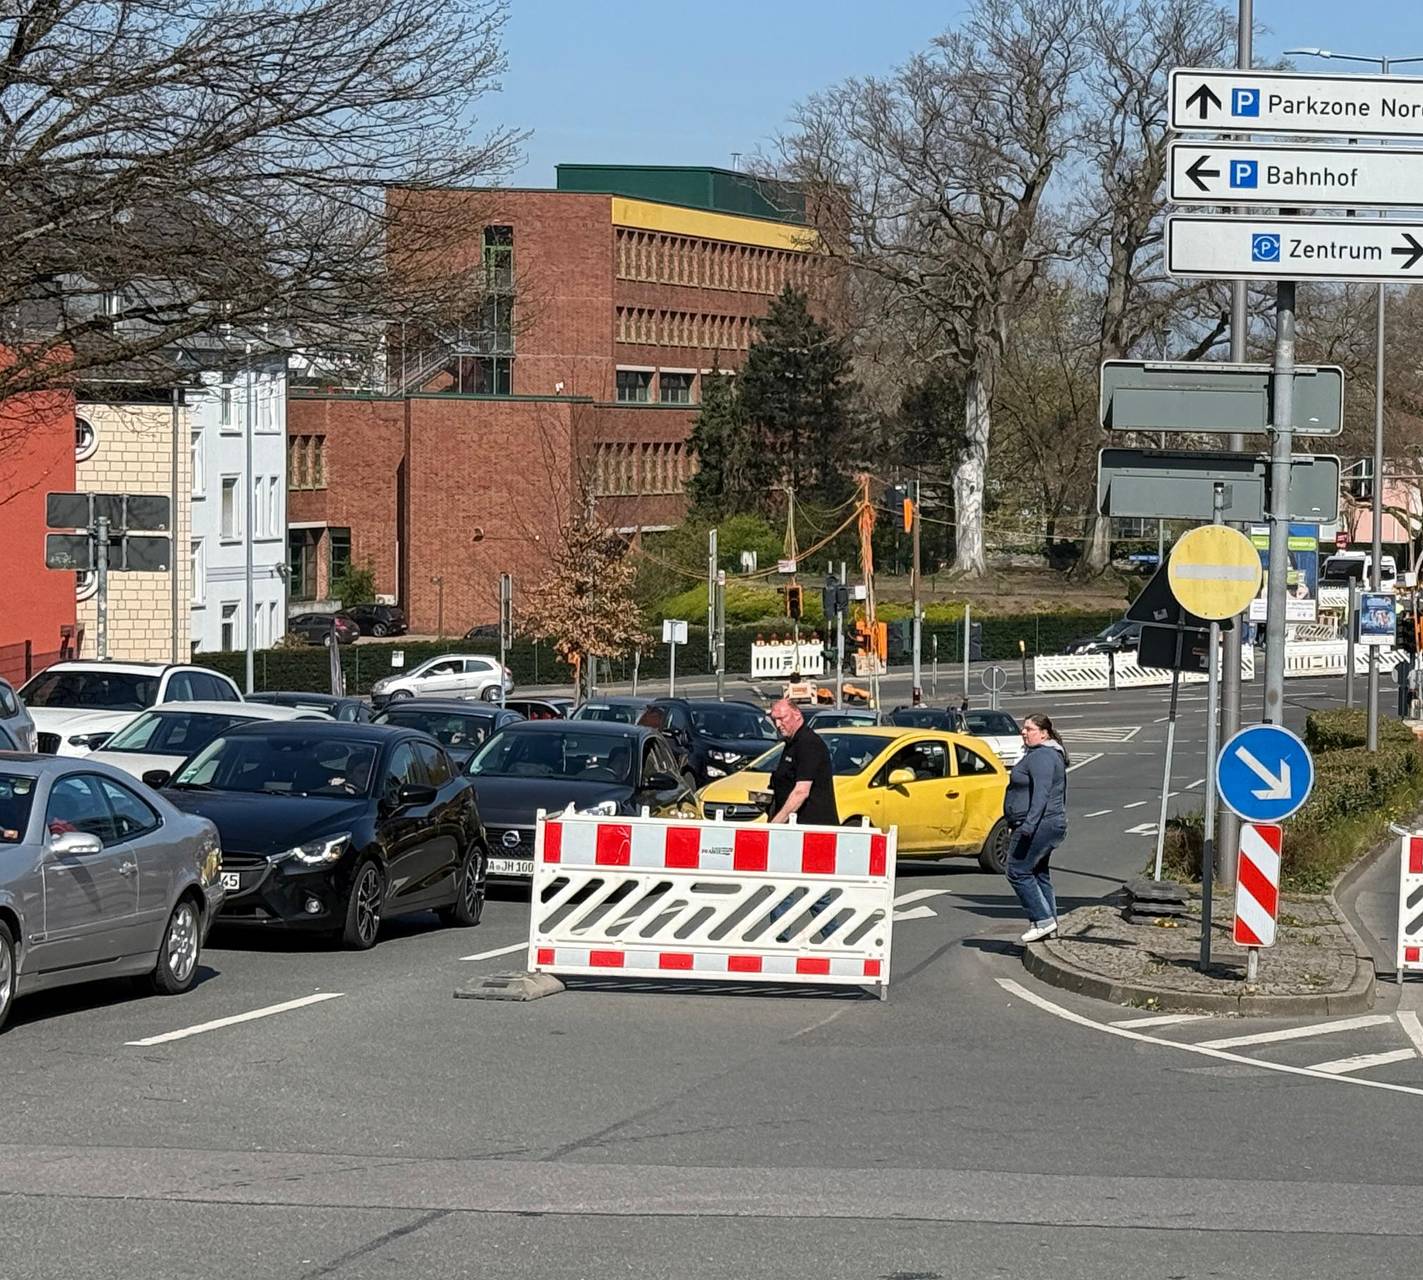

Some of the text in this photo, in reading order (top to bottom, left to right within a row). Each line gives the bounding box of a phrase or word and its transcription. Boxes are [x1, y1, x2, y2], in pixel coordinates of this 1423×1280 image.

[1237, 91, 1253, 113] P
[1268, 95, 1370, 117] Parkzone
[1236, 165, 1358, 187] P Bahnhof
[1290, 239, 1382, 260] Zentrum
